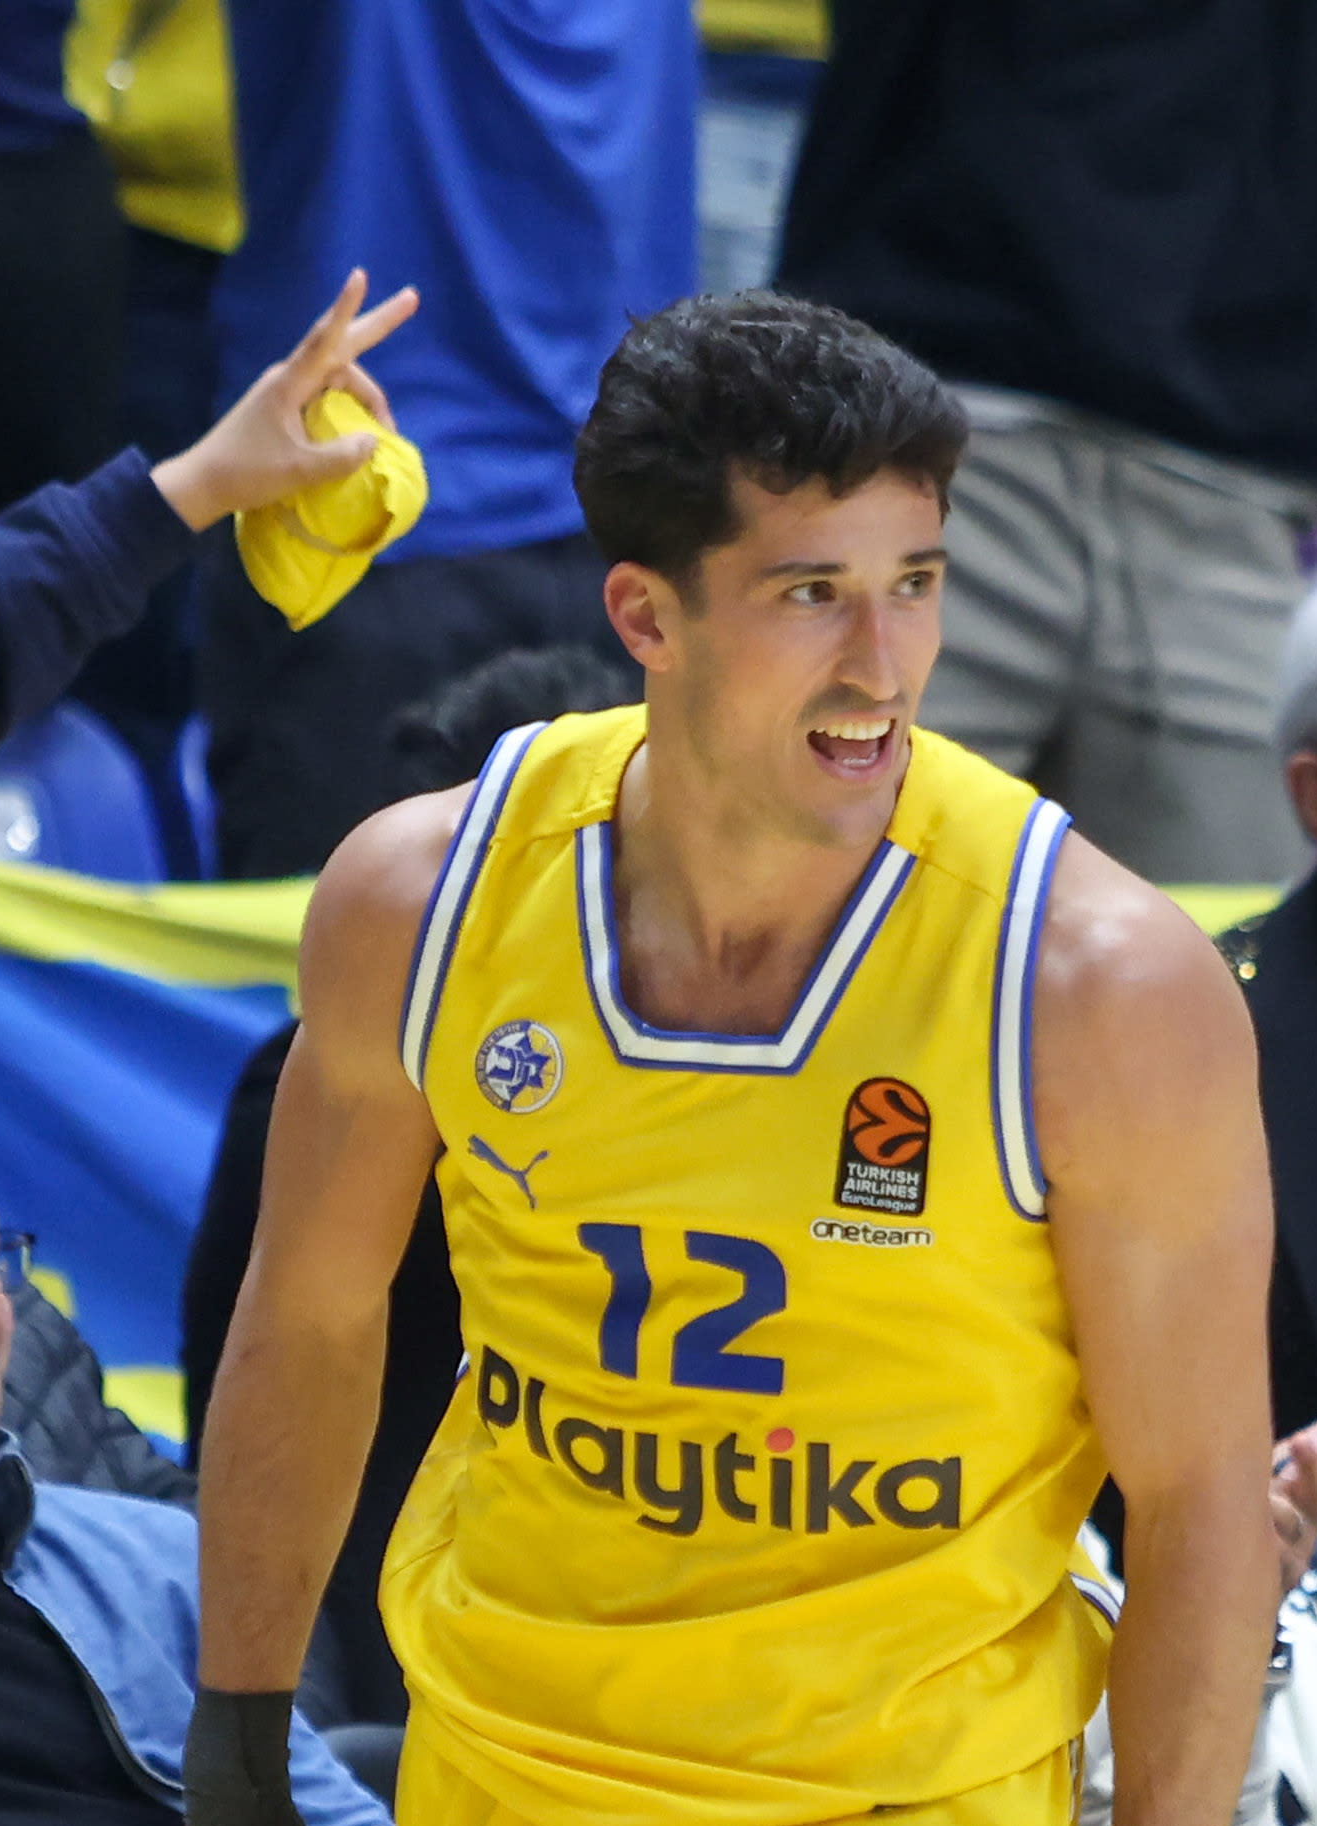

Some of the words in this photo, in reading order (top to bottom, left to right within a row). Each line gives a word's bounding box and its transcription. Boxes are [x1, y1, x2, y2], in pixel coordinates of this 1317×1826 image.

[847, 1162, 920, 1186] TURKISH
[843, 1177, 919, 1200] AIRLINES
[812, 1221, 931, 1246] oneteam
[577, 1222, 787, 1396] 12
[476, 1344, 962, 1537] Playtika
